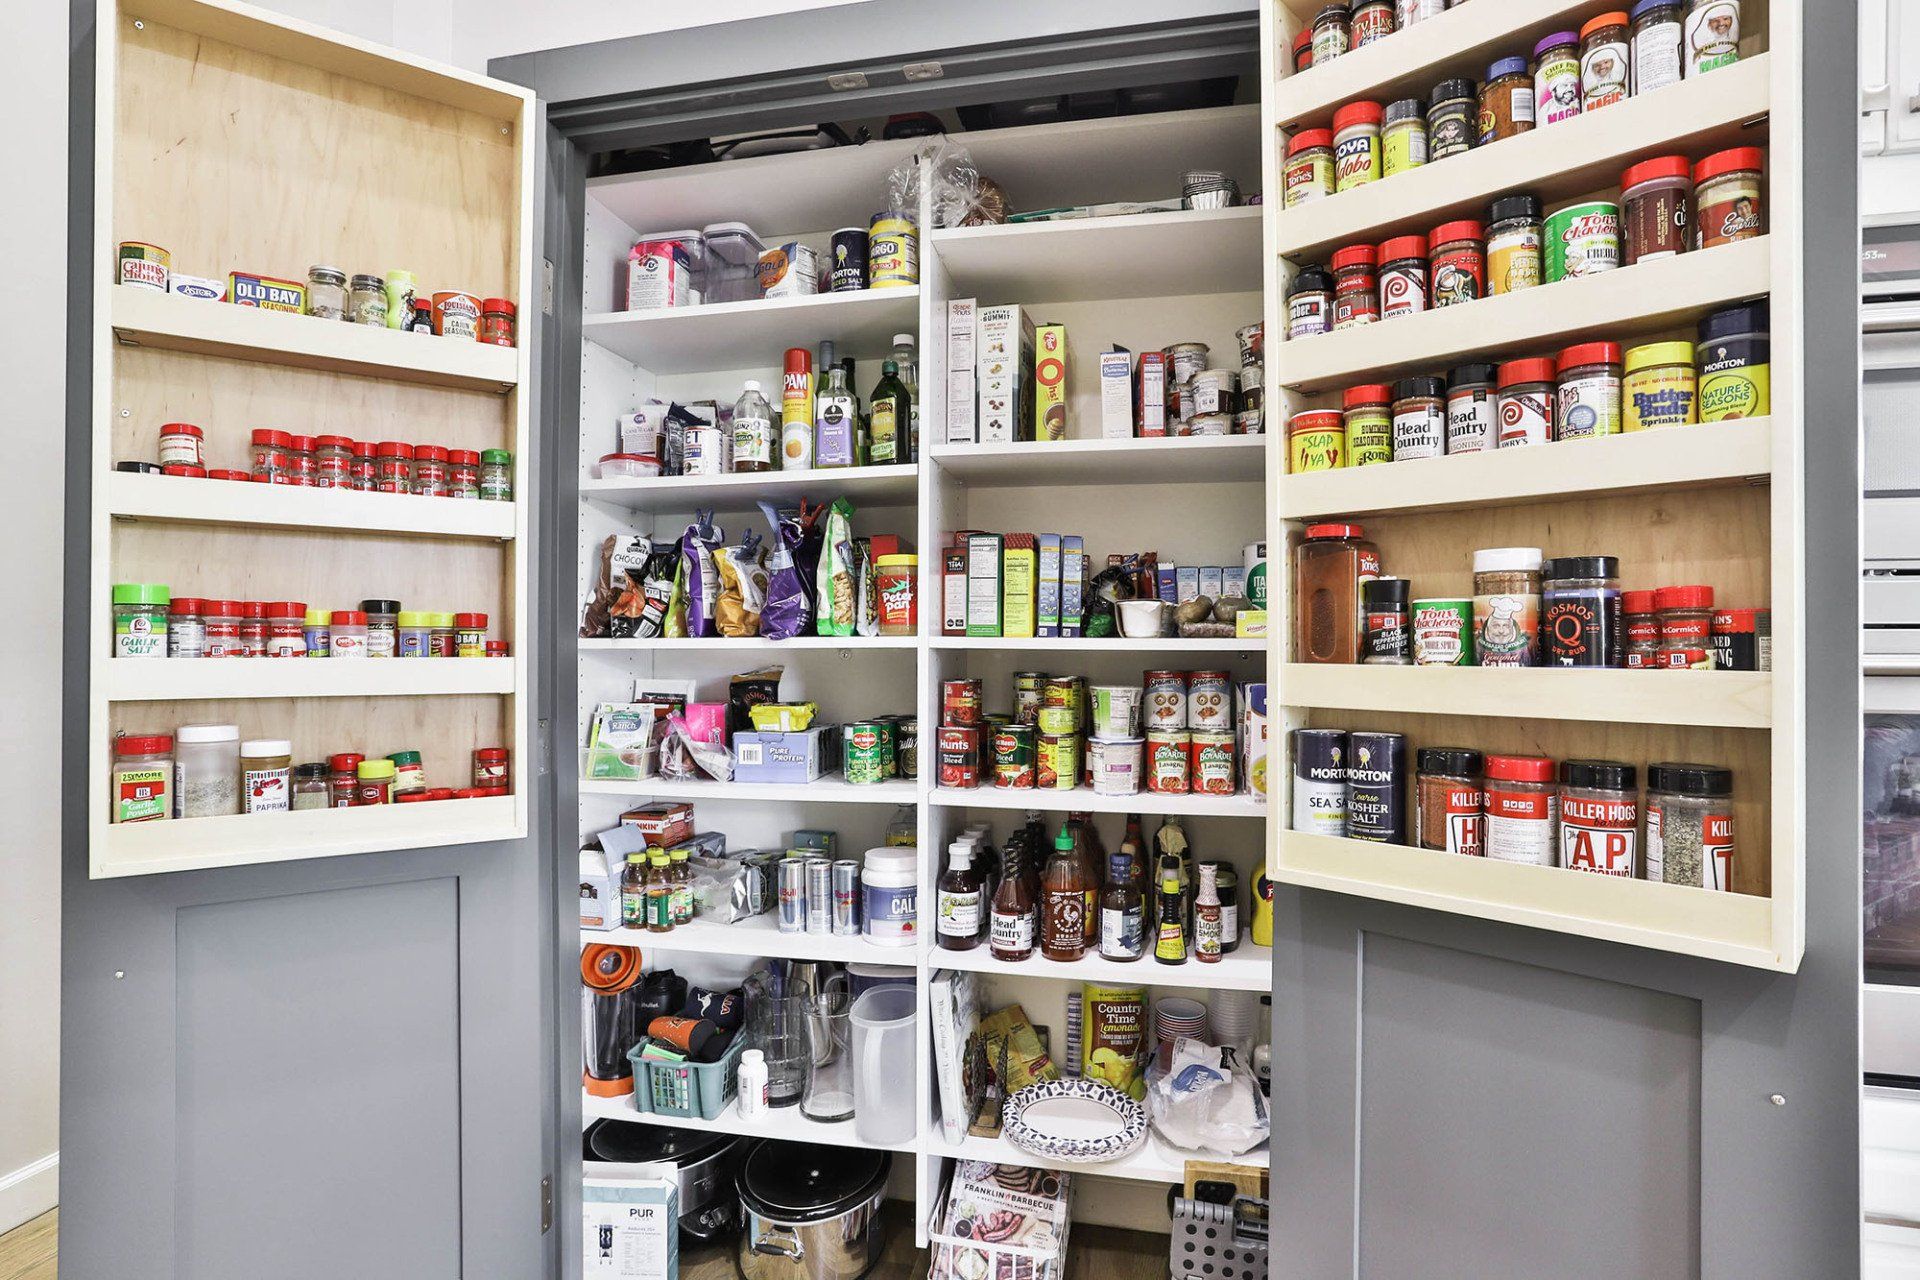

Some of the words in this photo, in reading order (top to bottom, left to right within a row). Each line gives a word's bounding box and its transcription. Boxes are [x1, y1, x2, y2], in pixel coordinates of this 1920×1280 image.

[236, 282, 266, 300] OLD
[1704, 358, 1745, 374] MORTON
[783, 373, 807, 391] PAM
[1702, 382, 1750, 400] NATURE'S
[1632, 388, 1694, 408] Butter
[1702, 392, 1750, 410] SEASONS
[1639, 402, 1690, 418] Buds
[1397, 419, 1431, 434] Head
[685, 430, 702, 444] ET
[614, 553, 645, 565] CHOCOL
[882, 591, 912, 603] Peter
[1547, 604, 1595, 621] KOSMOS
[1381, 628, 1403, 640] BLACK
[1554, 614, 1582, 647] Q
[121, 636, 160, 647] GARLIC
[1375, 640, 1409, 653] GRINDER
[126, 646, 153, 655] SALT
[1551, 645, 1568, 656] DRY
[1568, 645, 1588, 657] RUB
[769, 746, 789, 756] PURE
[773, 753, 806, 763] PROTEIN
[135, 771, 163, 781] MORE
[1347, 768, 1391, 784] MORTON
[1309, 796, 1332, 809] SEA
[1335, 796, 1348, 808] SA
[1351, 792, 1379, 804] Coarse
[255, 801, 287, 812] PAPRIKA
[1347, 801, 1389, 814] KOSHER
[1564, 800, 1604, 819] KILLER
[1608, 801, 1637, 819] HOGS
[1352, 812, 1379, 825] SALT
[1711, 819, 1734, 838] KILL
[783, 887, 797, 897] Bull
[993, 917, 1016, 930] Head
[1097, 1003, 1142, 1018] Country
[1106, 1013, 1136, 1025] Time
[964, 1183, 1005, 1200] FRANKLIN
[1010, 1193, 1055, 1211] BARBECUE
[629, 1208, 653, 1218] PUR
